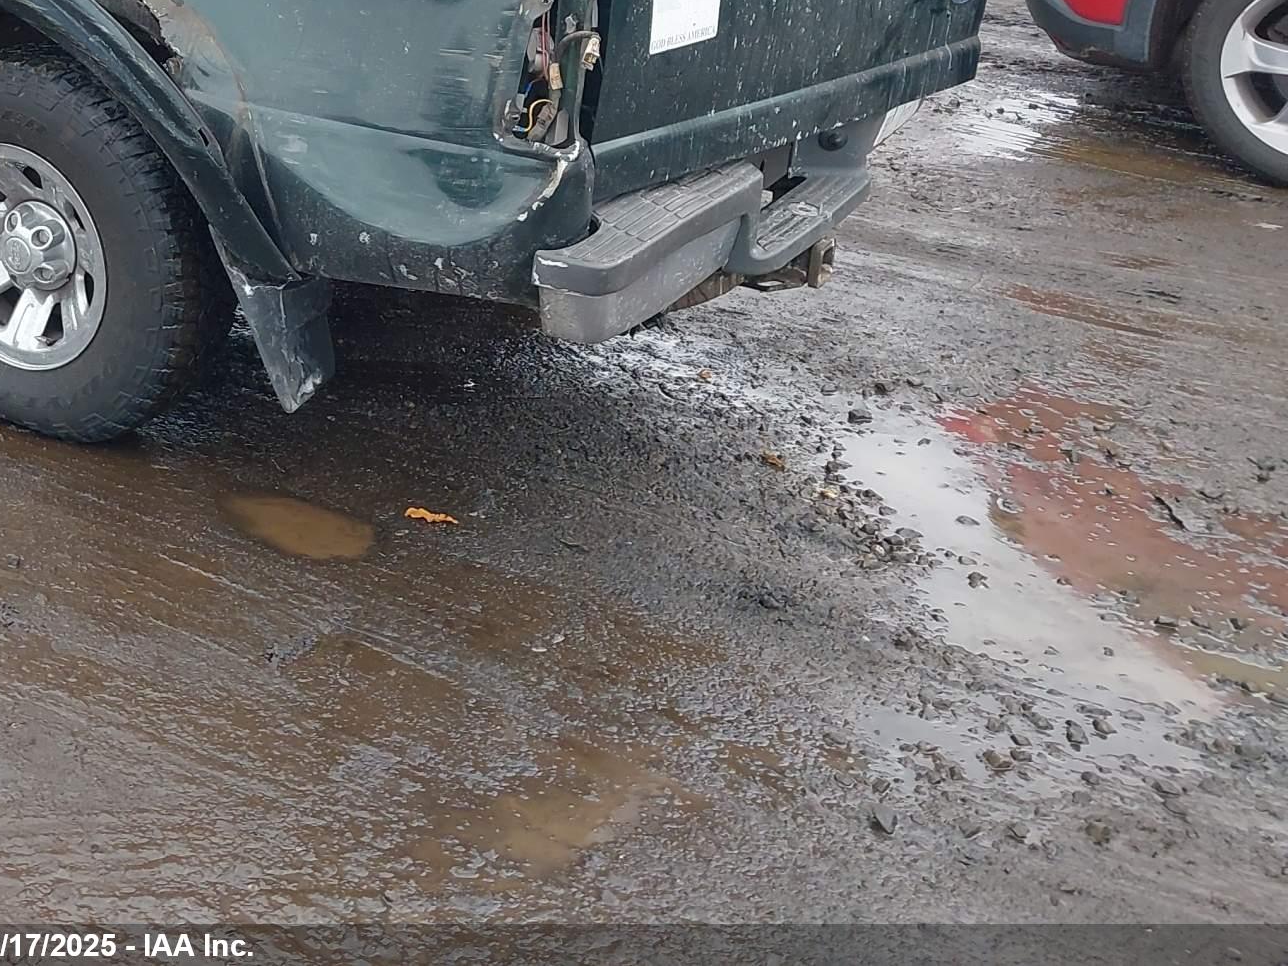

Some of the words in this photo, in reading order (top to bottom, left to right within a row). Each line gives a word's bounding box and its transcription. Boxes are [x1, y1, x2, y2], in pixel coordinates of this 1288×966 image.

[651, 38, 666, 51] GOD
[667, 33, 686, 47] BLESS
[687, 25, 717, 41] AMERICA
